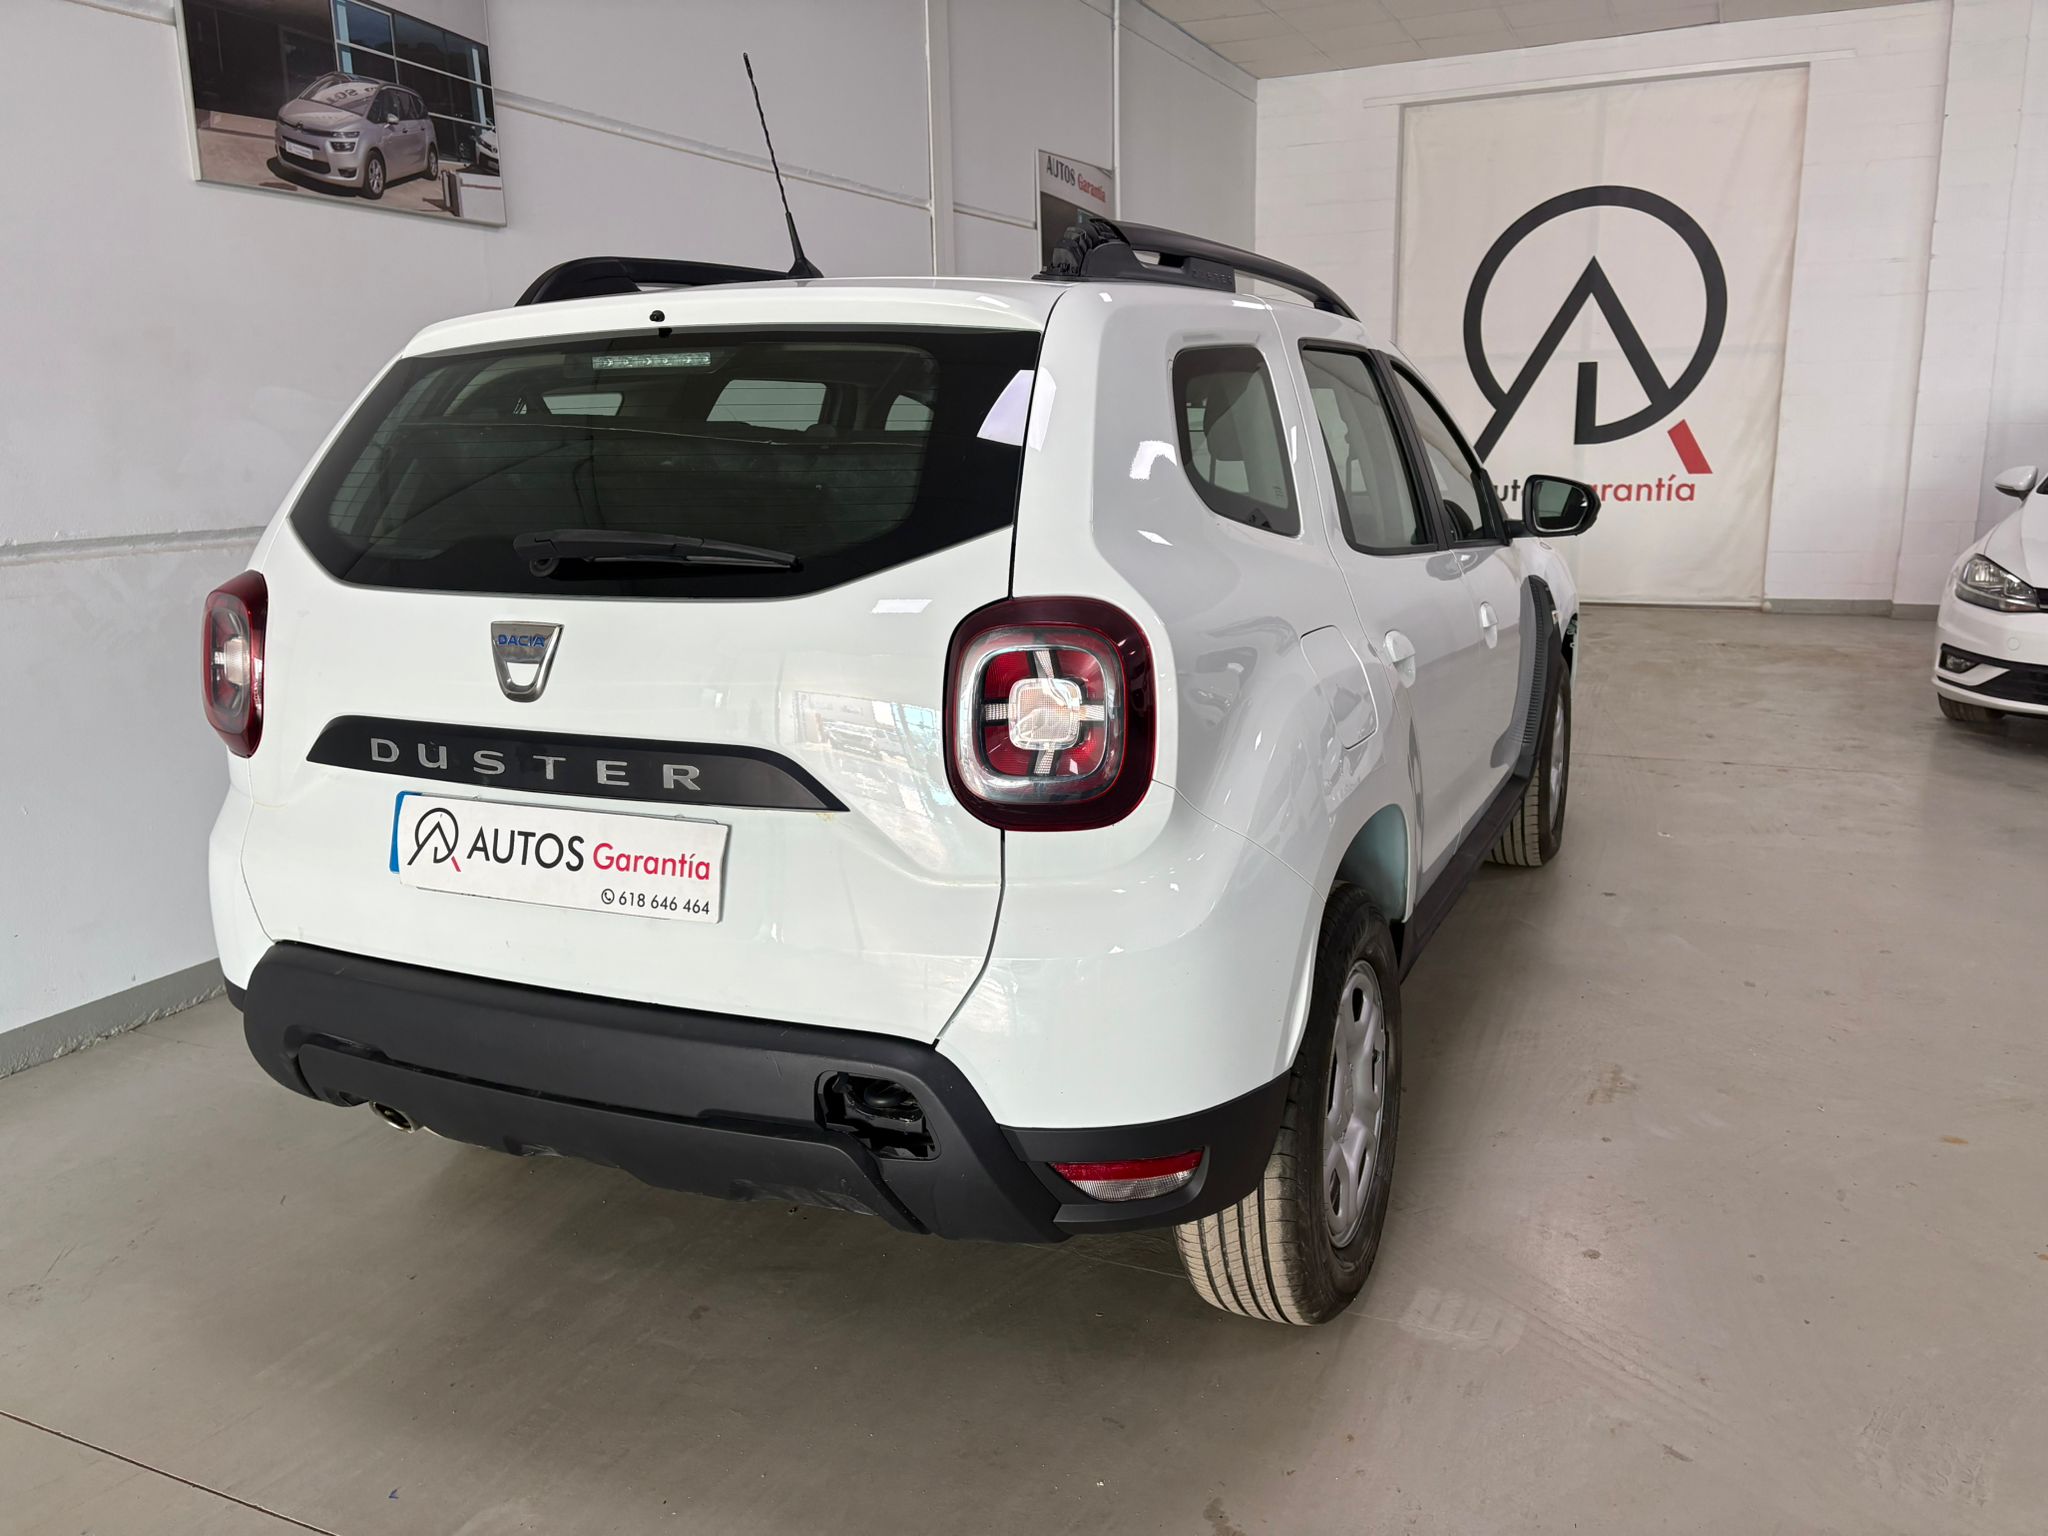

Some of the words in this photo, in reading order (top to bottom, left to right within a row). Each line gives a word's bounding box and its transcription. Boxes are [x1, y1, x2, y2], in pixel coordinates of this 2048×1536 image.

[1046, 155, 1076, 186] AUTOS
[1591, 473, 1697, 502] rantía
[498, 633, 545, 648] DACIA
[369, 737, 701, 791] DUSTER
[466, 825, 585, 872] AUTOS
[592, 842, 711, 880] Garantía
[618, 890, 646, 908] 618
[650, 894, 678, 911] 646
[683, 898, 710, 915] 464
